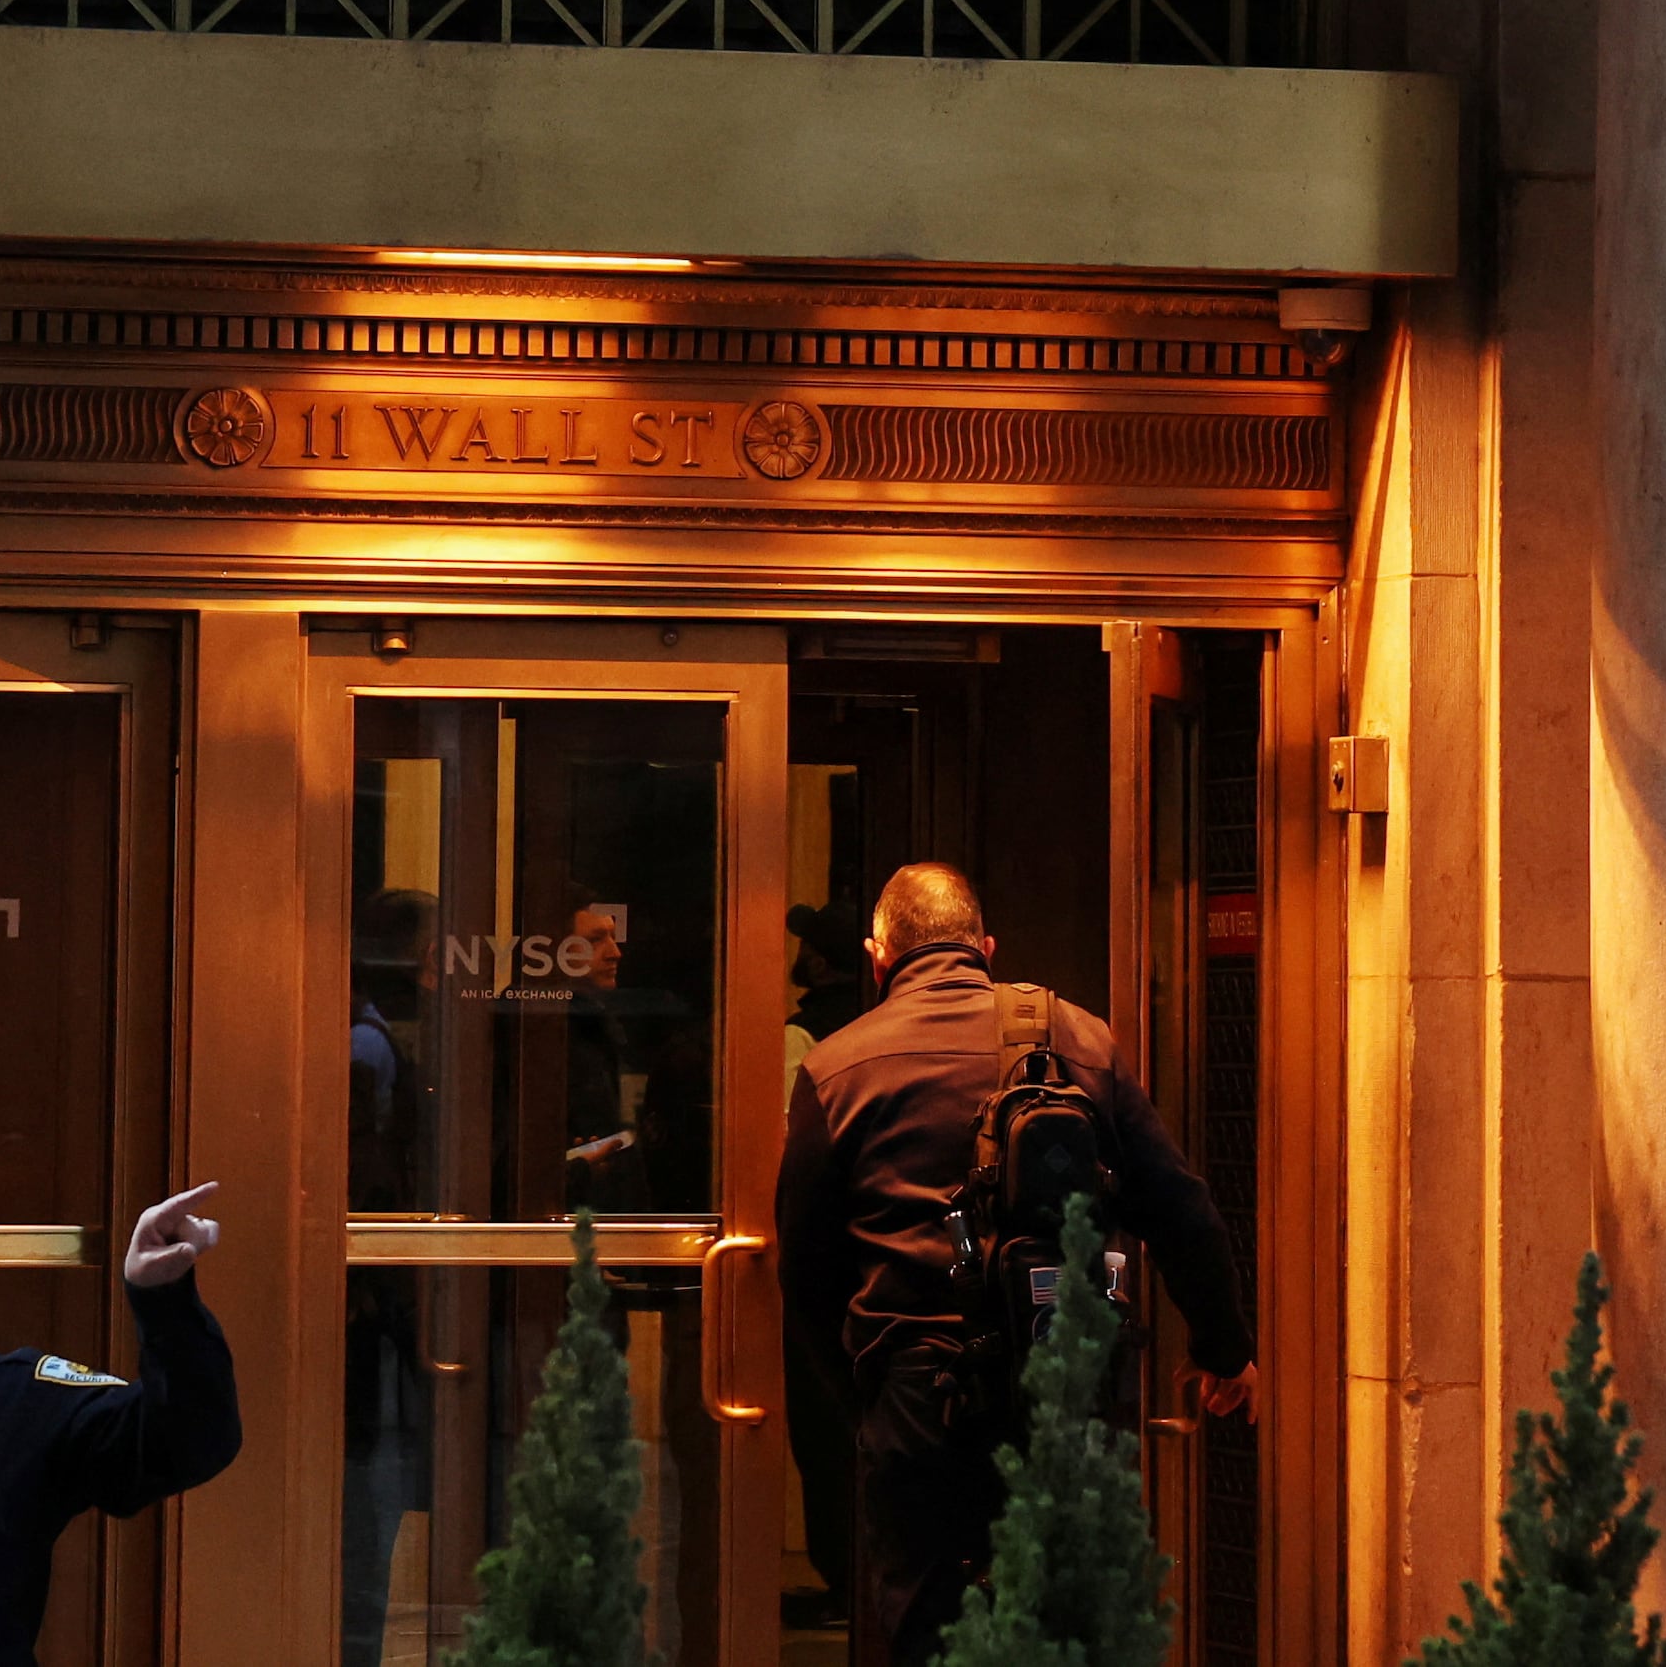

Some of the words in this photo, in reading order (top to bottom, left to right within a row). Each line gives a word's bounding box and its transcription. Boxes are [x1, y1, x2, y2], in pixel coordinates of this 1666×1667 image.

[301, 404, 349, 459] 11
[375, 405, 597, 465] WALL
[630, 409, 714, 468] ST
[461, 989, 477, 999] AN
